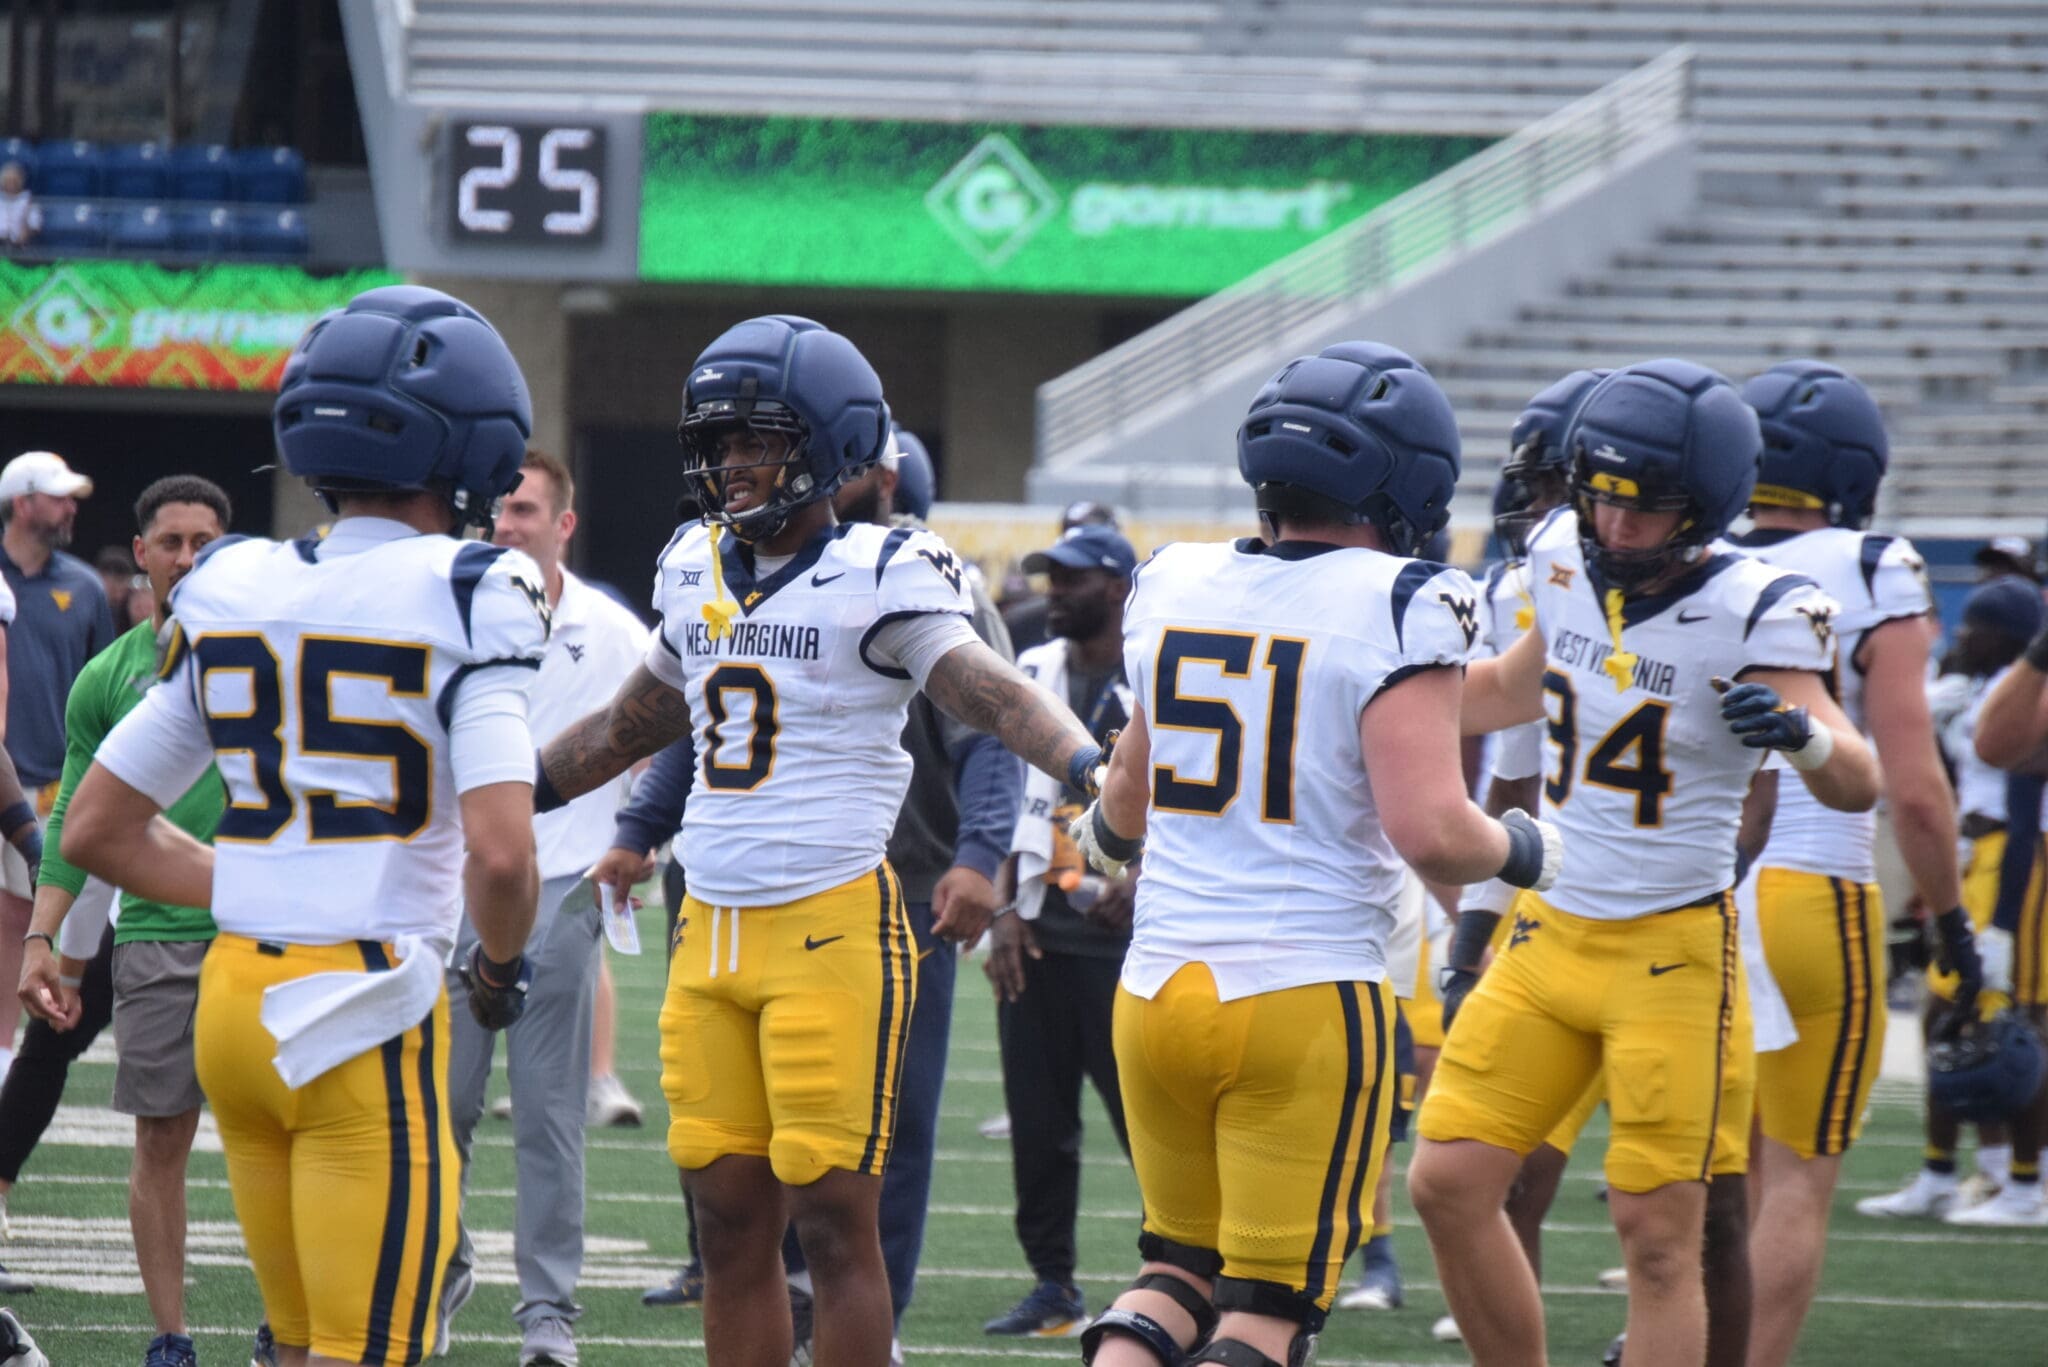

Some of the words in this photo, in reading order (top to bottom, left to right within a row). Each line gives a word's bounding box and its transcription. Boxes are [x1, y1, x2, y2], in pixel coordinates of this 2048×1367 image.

[458, 125, 599, 233] 25
[727, 623, 821, 661] VIRGINIA
[192, 631, 434, 845] 85
[703, 661, 781, 793] 0
[1152, 626, 1311, 826] 51
